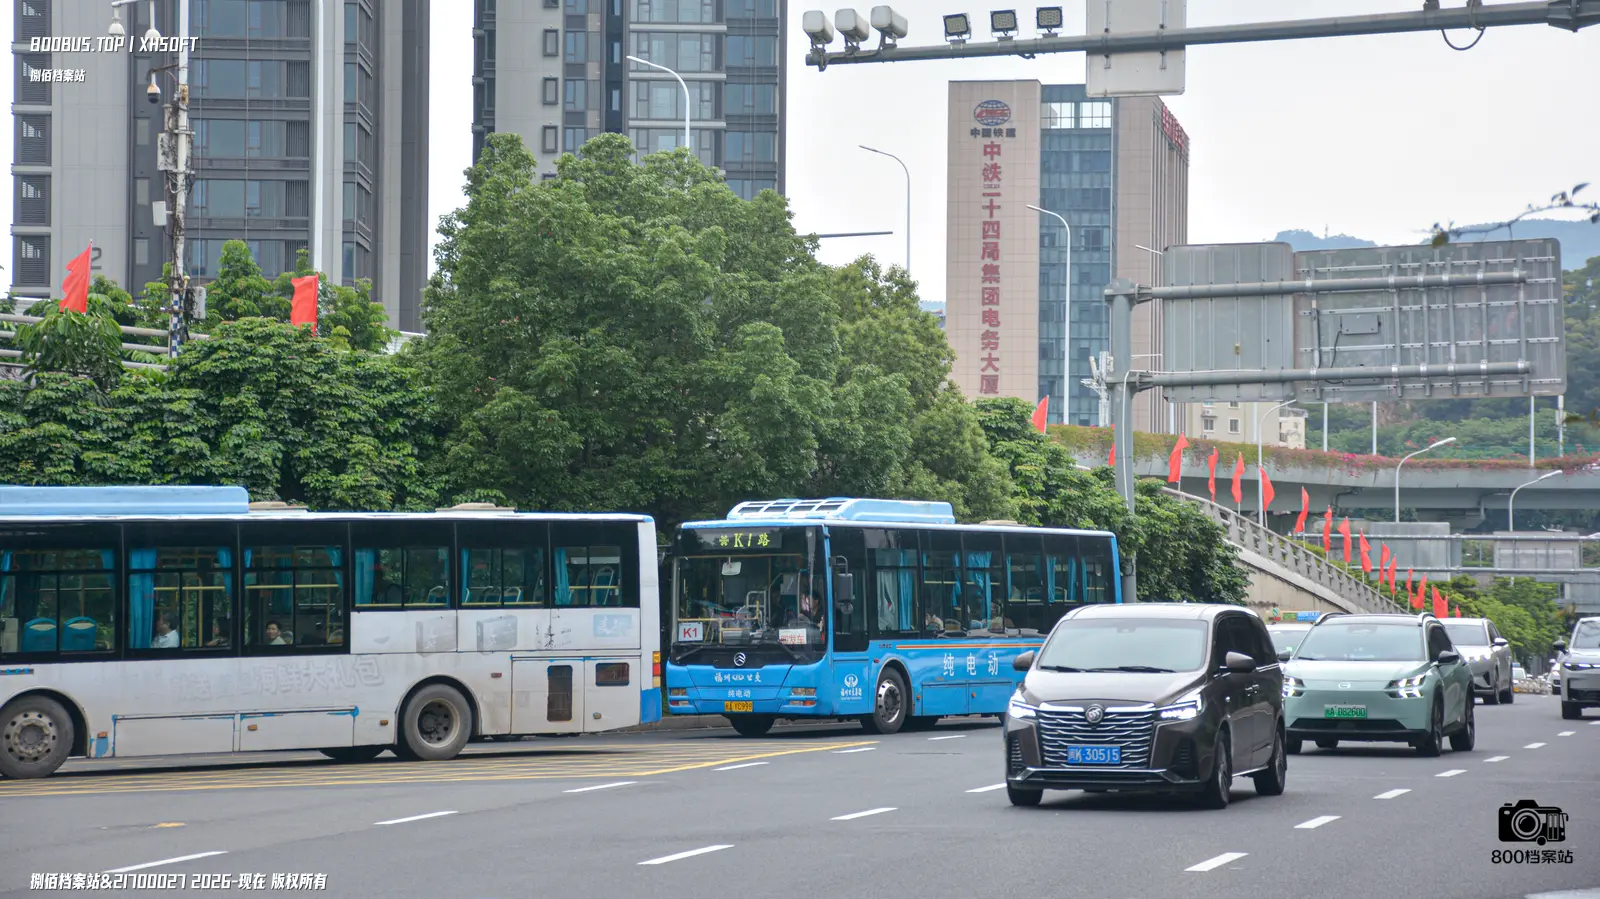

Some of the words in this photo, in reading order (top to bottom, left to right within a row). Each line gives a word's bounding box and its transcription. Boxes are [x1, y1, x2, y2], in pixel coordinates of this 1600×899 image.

[970, 127, 1016, 138] 中国铁建
[980, 140, 1002, 394] 中铁二十四局集团电务大厦
[683, 627, 698, 638] K1
[943, 652, 999, 676] 纯电动
[727, 689, 751, 698] 纯电动
